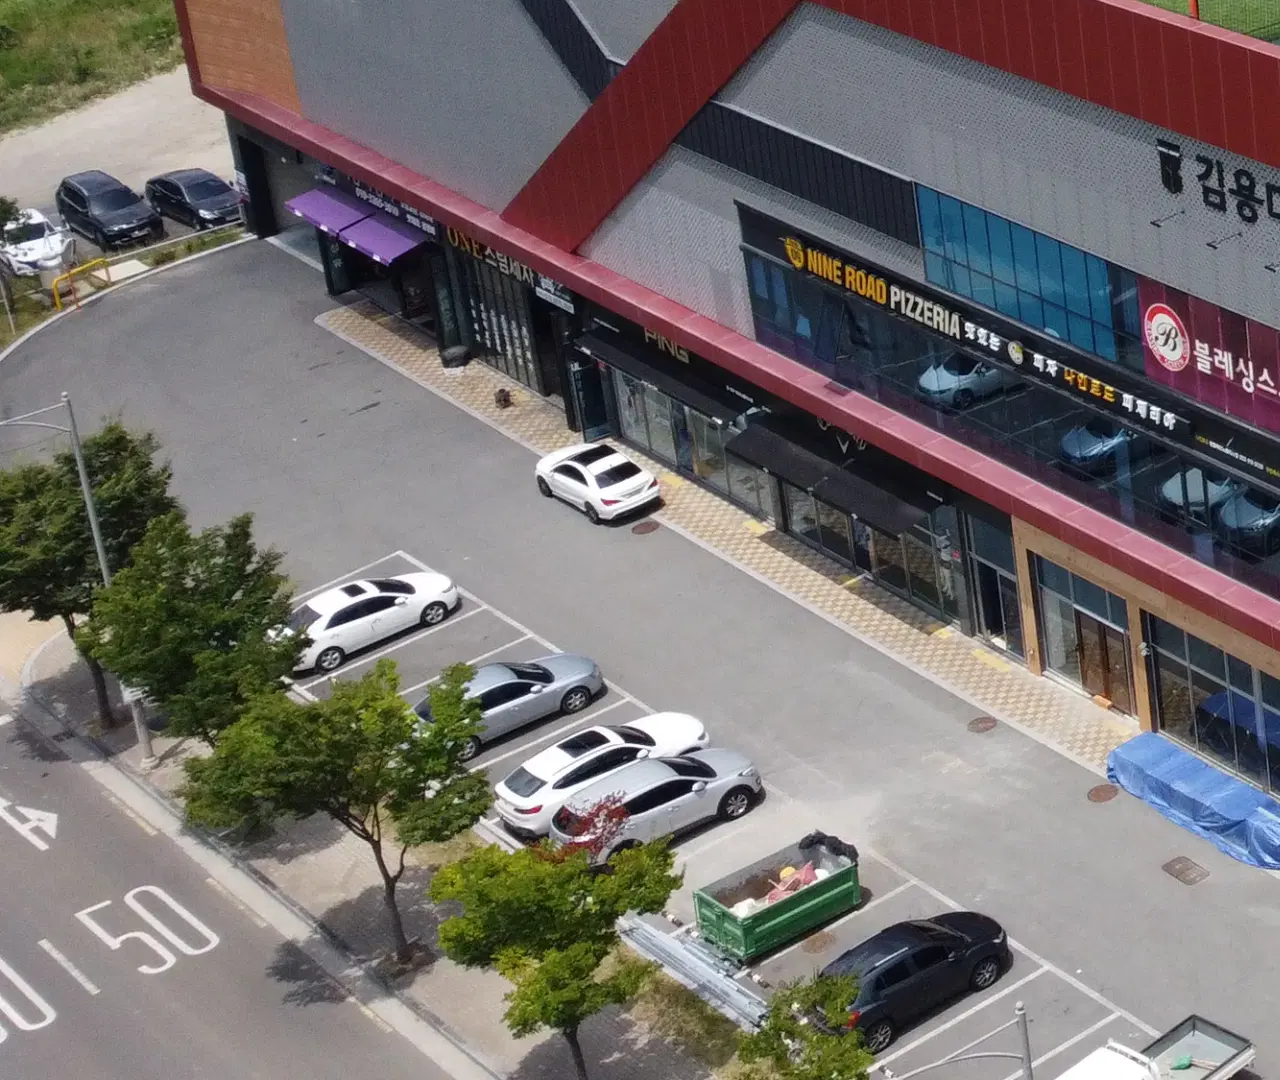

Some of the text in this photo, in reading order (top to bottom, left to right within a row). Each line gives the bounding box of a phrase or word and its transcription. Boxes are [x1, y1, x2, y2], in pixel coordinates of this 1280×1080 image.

[807, 248, 962, 340] NINE ROAD PIZZERIA
[644, 328, 690, 364] PING
[74, 885, 220, 974] 50
